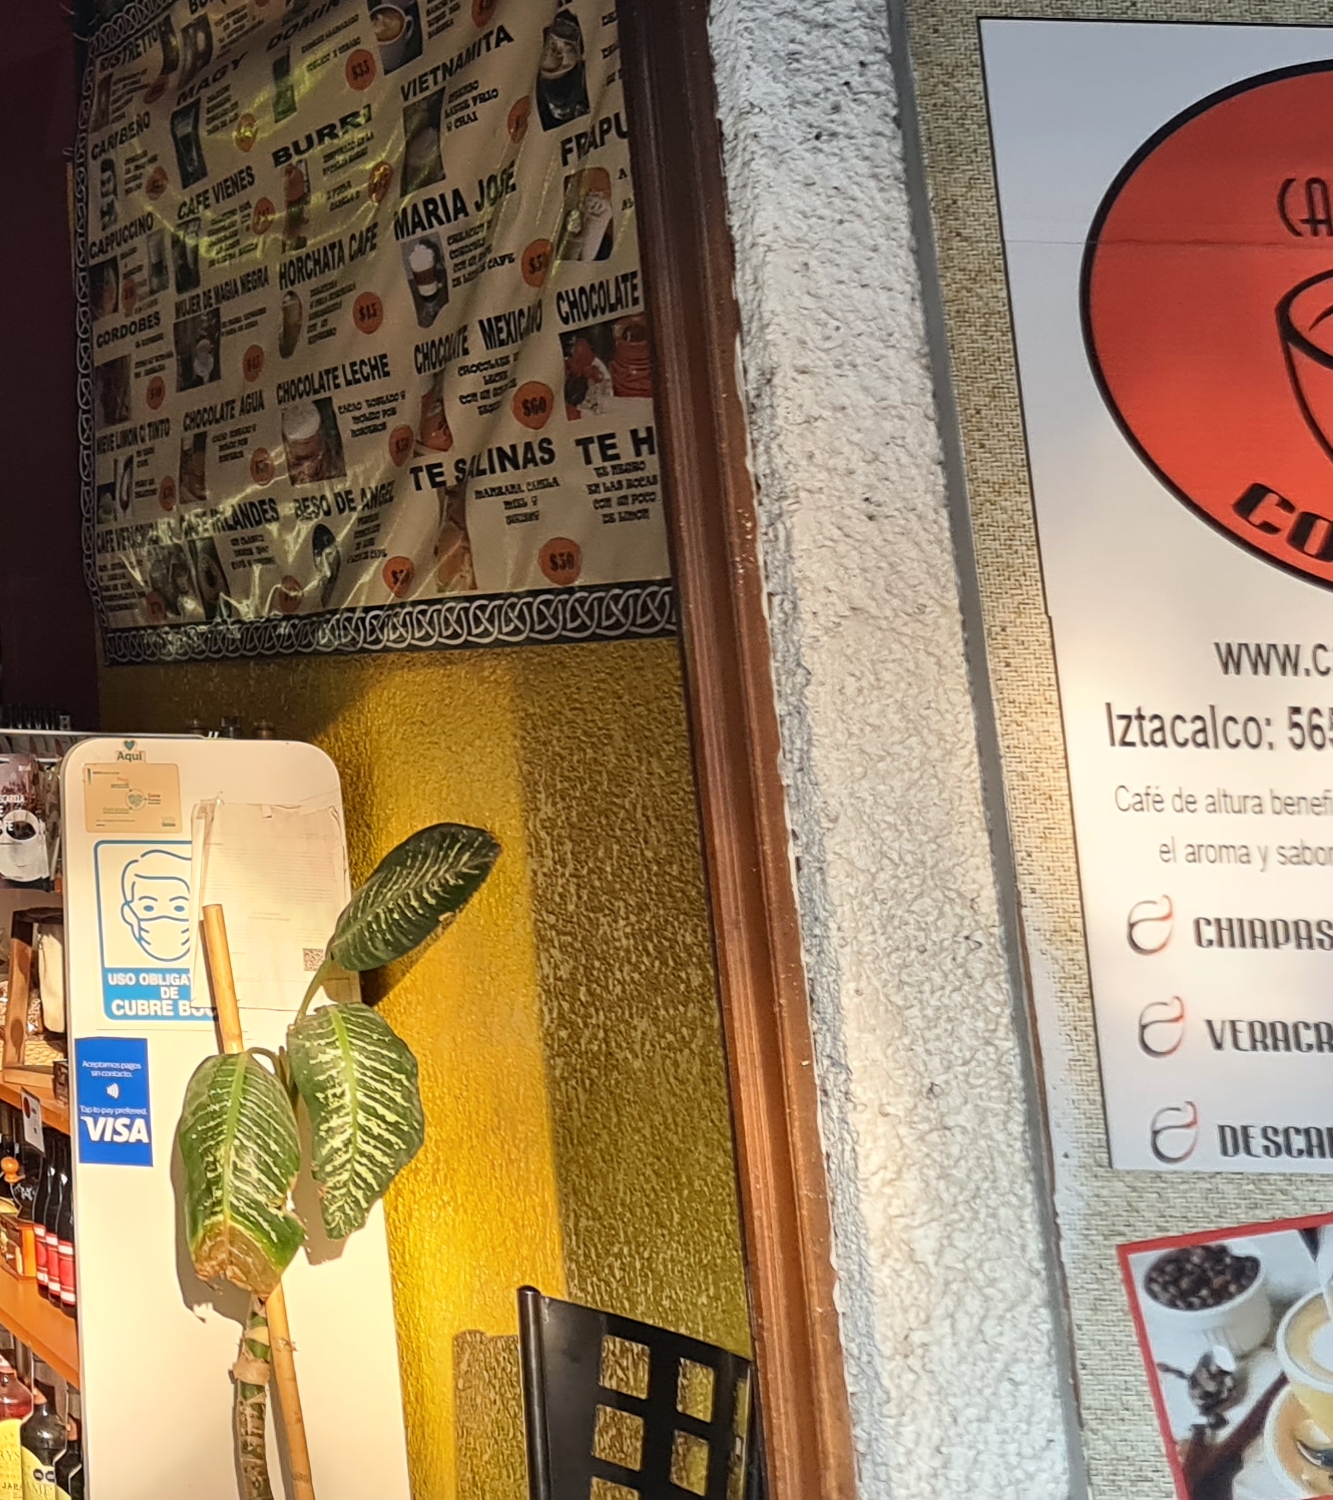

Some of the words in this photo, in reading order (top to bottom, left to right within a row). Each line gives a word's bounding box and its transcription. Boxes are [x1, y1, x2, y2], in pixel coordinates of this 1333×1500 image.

[400, 25, 515, 102] VIETNAMITA
[212, 165, 256, 206] VIENES
[394, 188, 469, 241] MARIA
[89, 212, 155, 260] CAPPUCCINO
[279, 239, 346, 290] HORCHATA
[348, 222, 379, 263] CAFE
[557, 271, 640, 326] CHOCOLATE
[96, 311, 162, 349] CORDOBES
[276, 366, 341, 405] CHOCOLATE
[342, 353, 391, 387] LECHE
[183, 398, 236, 433] CHOCOLATE
[239, 389, 265, 417] AGUA
[410, 462, 447, 492] TE
[454, 437, 556, 486] SALINAS
[575, 432, 621, 466] TE
[335, 490, 357, 514] DE
[1212, 642, 1333, 678] www.c
[1105, 701, 1275, 751] Iztacalco:
[1287, 706, 1333, 751] 56
[1114, 784, 1165, 812] Café
[1171, 786, 1197, 813] de
[1204, 787, 1264, 815] altura
[1159, 836, 1177, 863] el
[1184, 843, 1251, 864] aroma
[1256, 845, 1269, 873] y
[1192, 916, 1333, 950] CHIAPAS
[108, 972, 137, 986] USO
[139, 972, 192, 986] OBLIGA
[160, 986, 179, 999] DE
[111, 999, 175, 1016] CUBRE
[80, 1116, 150, 1143] VISA
